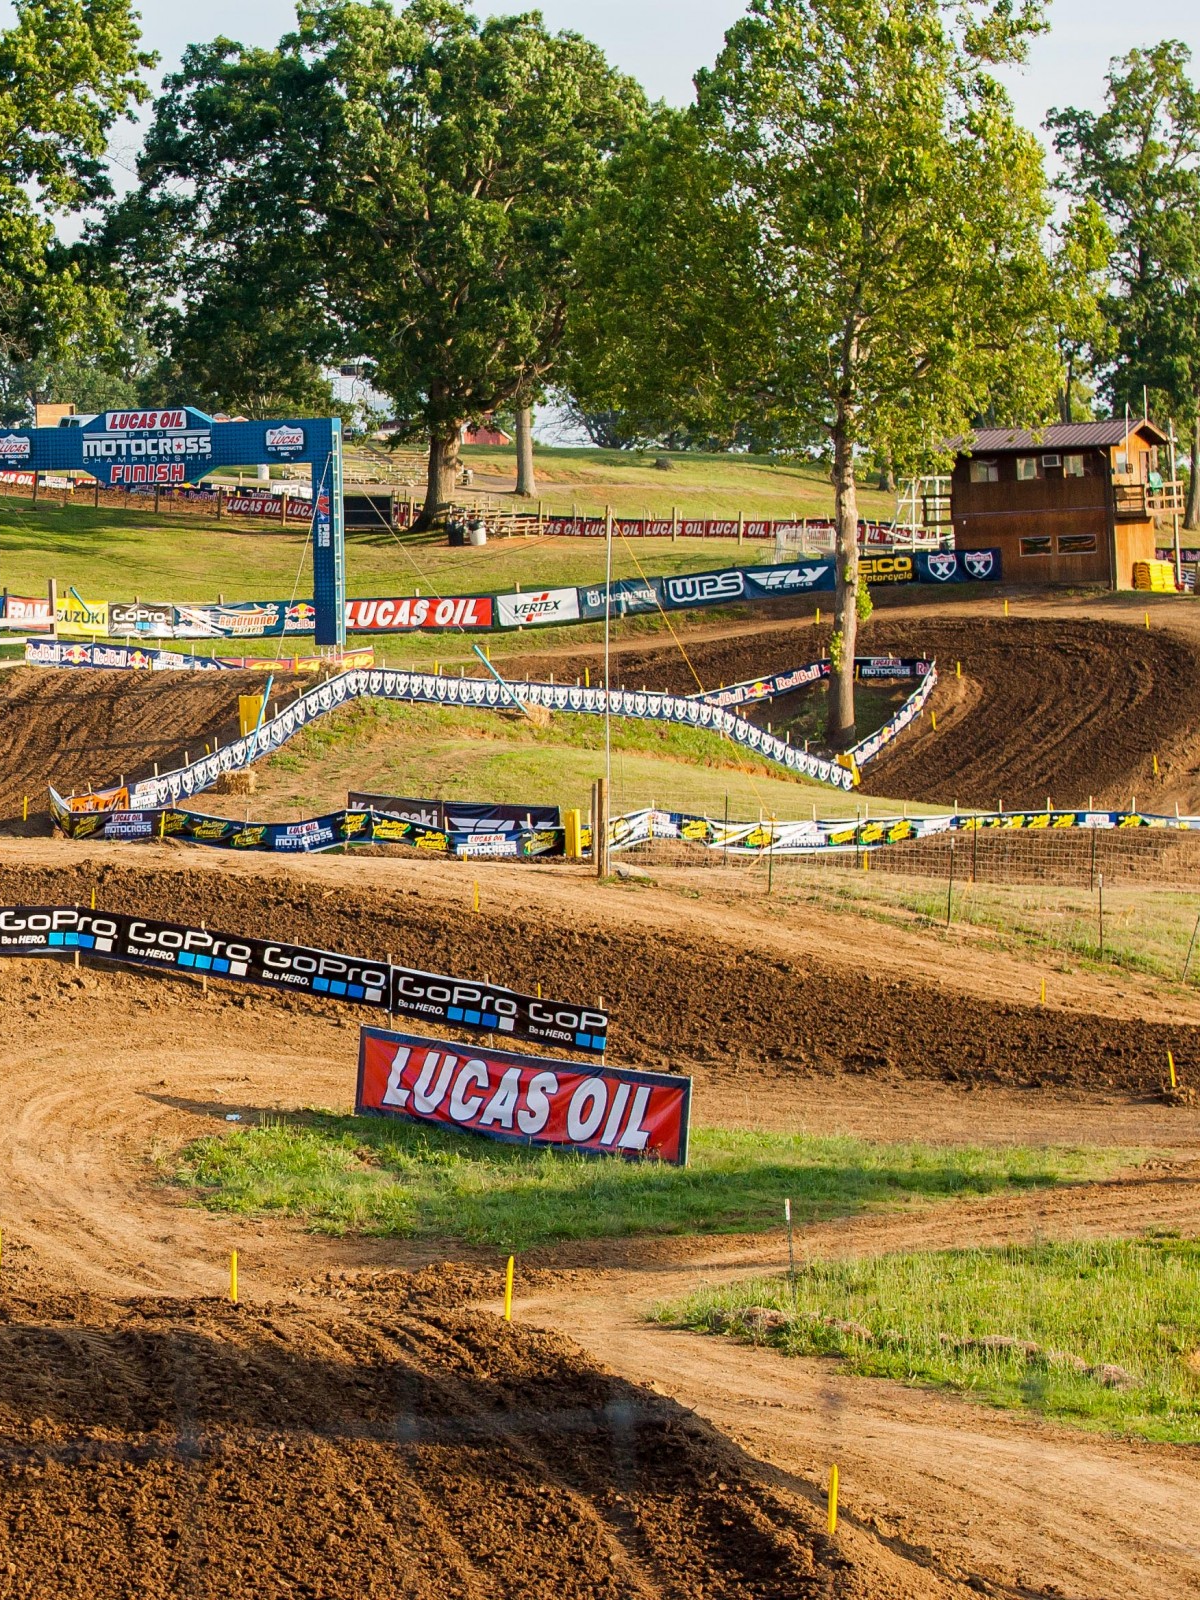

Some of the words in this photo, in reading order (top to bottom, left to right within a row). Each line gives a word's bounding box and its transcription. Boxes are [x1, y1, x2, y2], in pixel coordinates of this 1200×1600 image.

[110, 413, 156, 429] LUCAS
[159, 411, 185, 428] OIL
[128, 430, 164, 438] PRO
[270, 435, 301, 444] LUCAS
[0, 444, 29, 453] LUCAS
[82, 437, 212, 457] MOTOCROSS
[82, 454, 213, 464] CHAMPIONSHIP
[17, 474, 34, 486] OIL
[110, 463, 185, 483] FINISH
[227, 499, 263, 512] LUCAS
[264, 501, 281, 513] OIL
[584, 524, 619, 536] LUCS
[622, 523, 640, 535] OIL
[685, 523, 703, 535] OIL
[747, 523, 765, 535] OIL
[858, 557, 912, 574] EICO
[669, 571, 745, 602] WPS
[765, 581, 813, 590] RACING
[345, 600, 429, 627] LUCAS
[434, 599, 479, 625] OIL
[514, 599, 562, 615] VERTEX
[112, 609, 165, 623] GoPro
[218, 614, 279, 628] Roadrunner
[104, 824, 152, 834] MOTOCROSS
[469, 835, 492, 843] LUCAS
[1, 935, 11, 945] Be
[18, 935, 46, 945] HERO.
[128, 945, 138, 955] Be
[146, 948, 176, 962] HERO.
[0, 911, 117, 938] GoPro
[128, 922, 251, 961] GoPro
[262, 947, 387, 988] GoPro
[398, 976, 518, 1017] GoPro
[528, 1003, 609, 1031] GoP
[262, 969, 272, 979] Be
[280, 972, 310, 986] HERO.
[398, 999, 408, 1008] Be
[415, 1002, 445, 1016] HERO.
[528, 1025, 538, 1034] Be
[545, 1027, 573, 1042] HERO.
[382, 1046, 558, 1135] LUCAS
[567, 1076, 652, 1150] OIL
